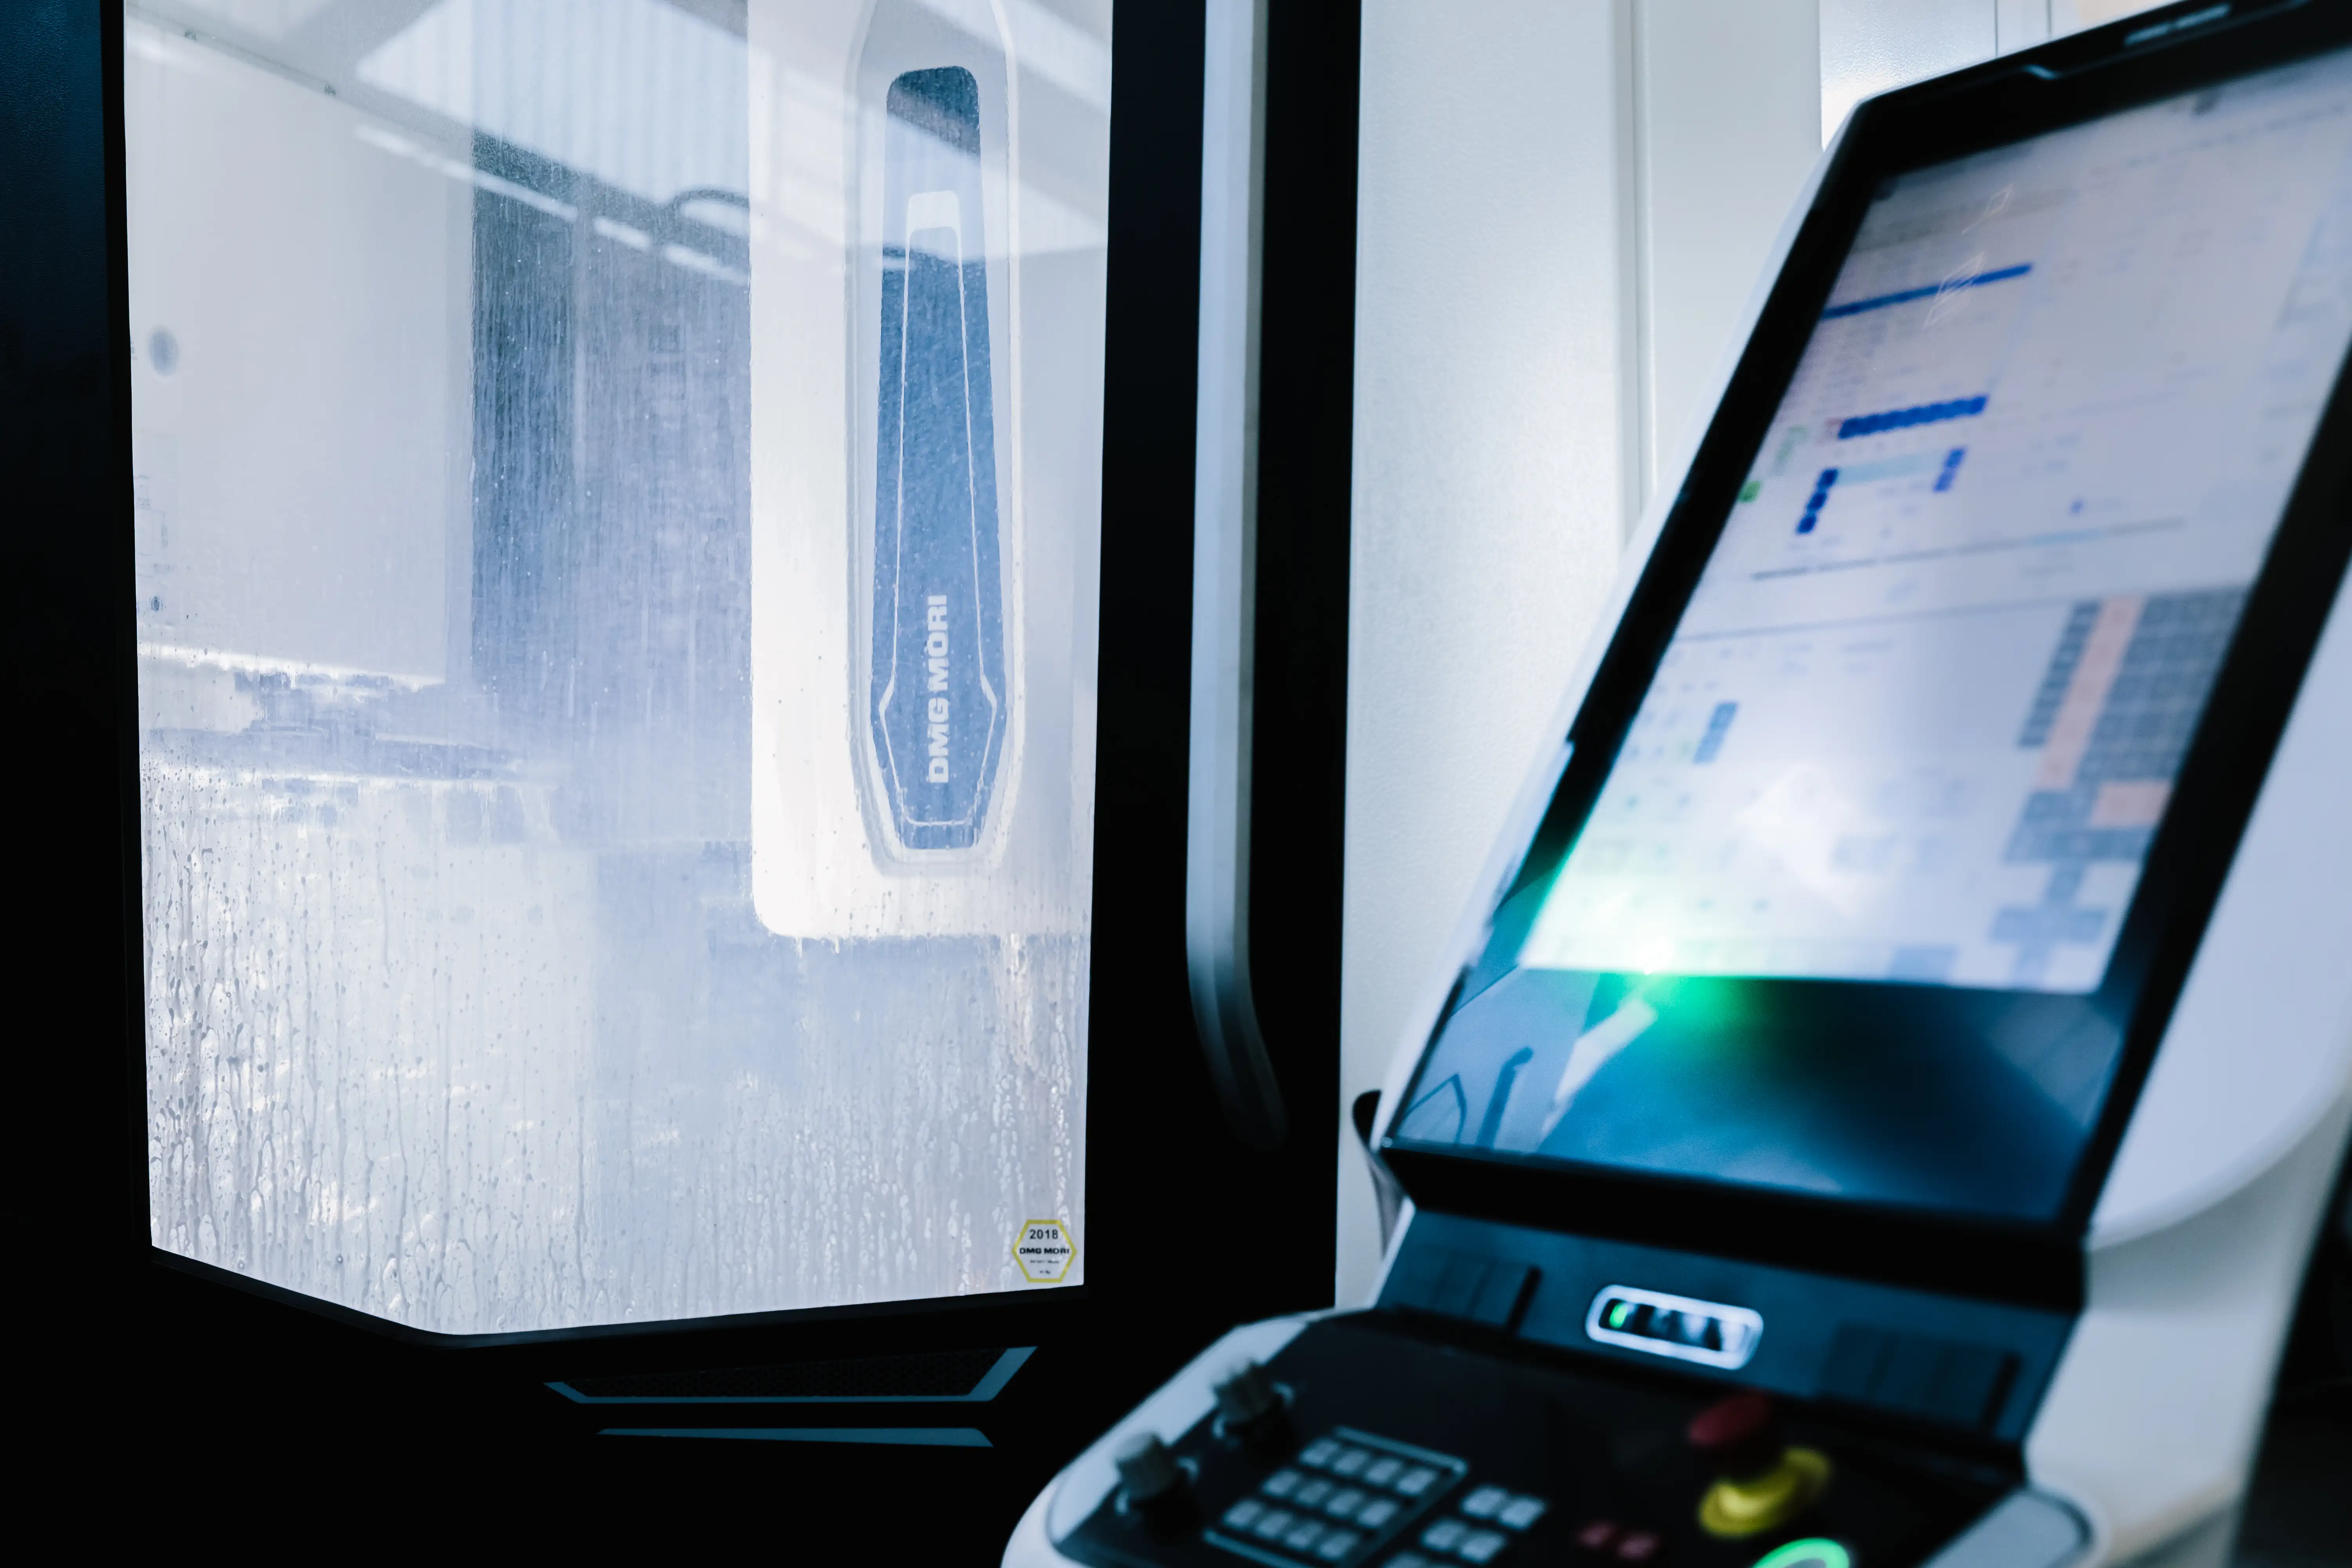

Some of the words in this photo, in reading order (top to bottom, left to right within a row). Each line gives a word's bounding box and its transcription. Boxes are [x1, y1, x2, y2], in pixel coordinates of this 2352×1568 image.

[928, 595, 949, 691] MORI
[928, 697, 949, 783] DMG
[1029, 1229, 1058, 1240] 2018
